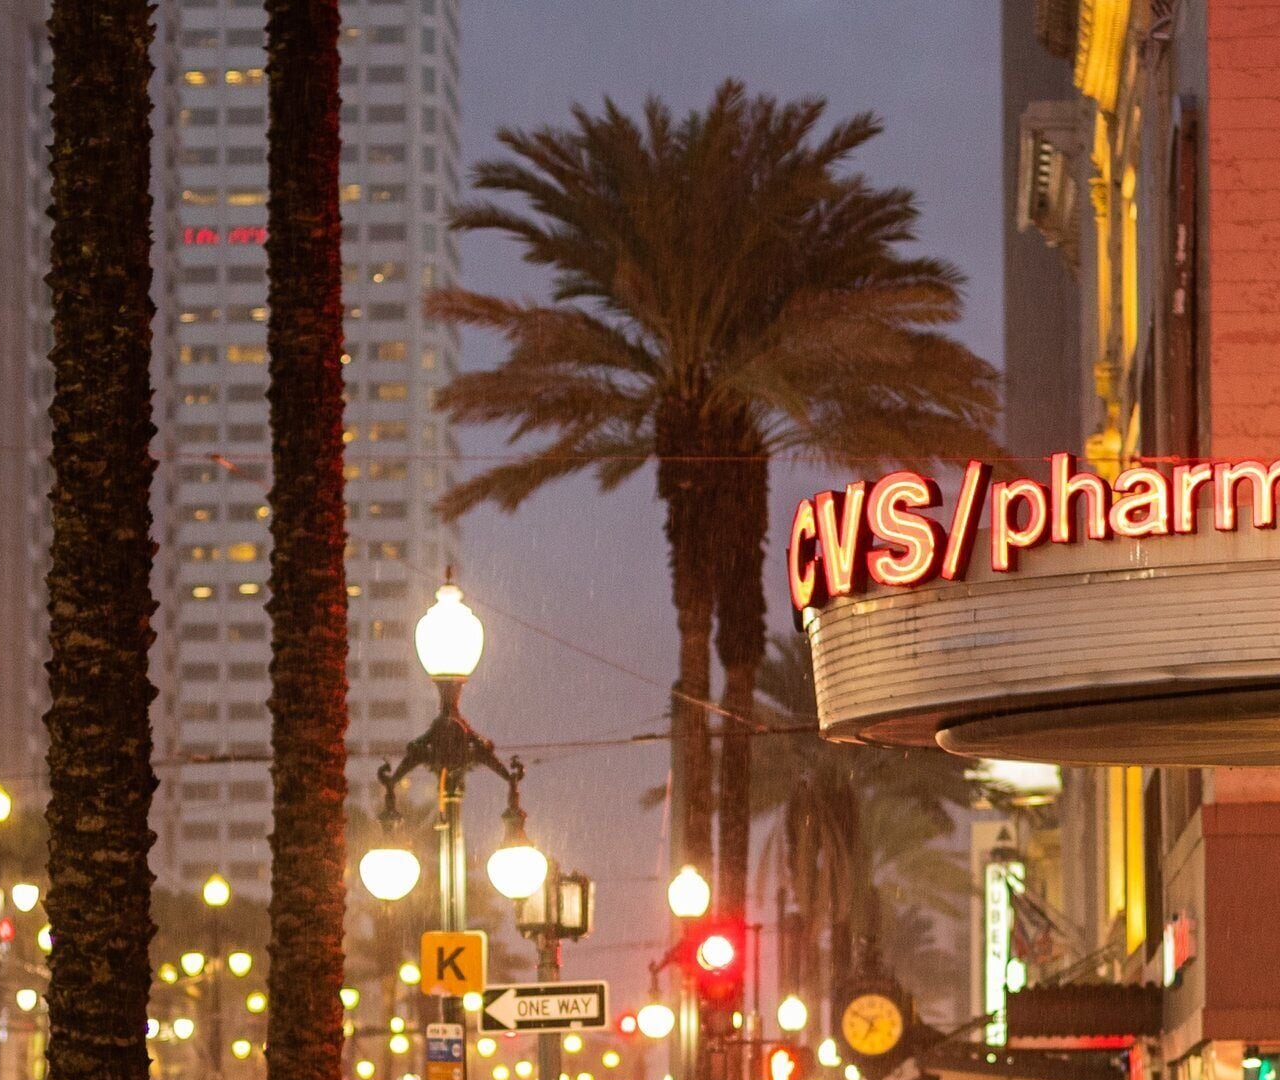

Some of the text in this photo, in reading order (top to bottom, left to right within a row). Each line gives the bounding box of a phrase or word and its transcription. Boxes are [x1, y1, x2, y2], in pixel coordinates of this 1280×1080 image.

[436, 946, 466, 981] K
[517, 998, 592, 1017] ONE WAY
